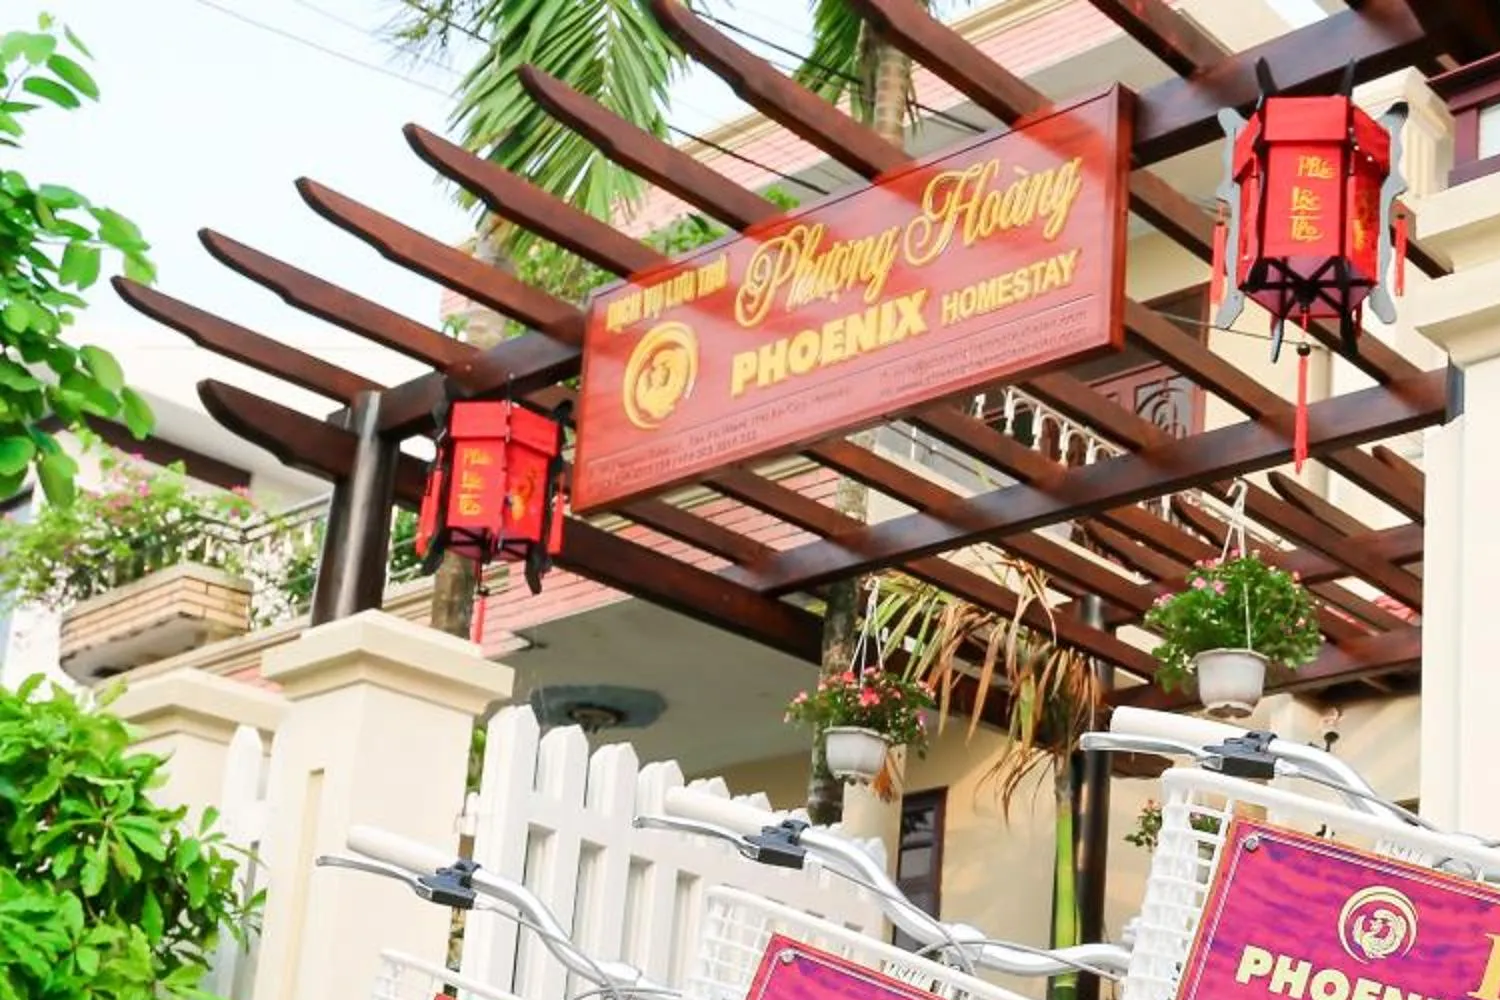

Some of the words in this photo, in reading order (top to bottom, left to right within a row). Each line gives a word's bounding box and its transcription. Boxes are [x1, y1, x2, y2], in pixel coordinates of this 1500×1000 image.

[904, 157, 1082, 267] Hoàng
[730, 289, 930, 397] PHOENIX
[940, 249, 1080, 327] HOMESTAY
